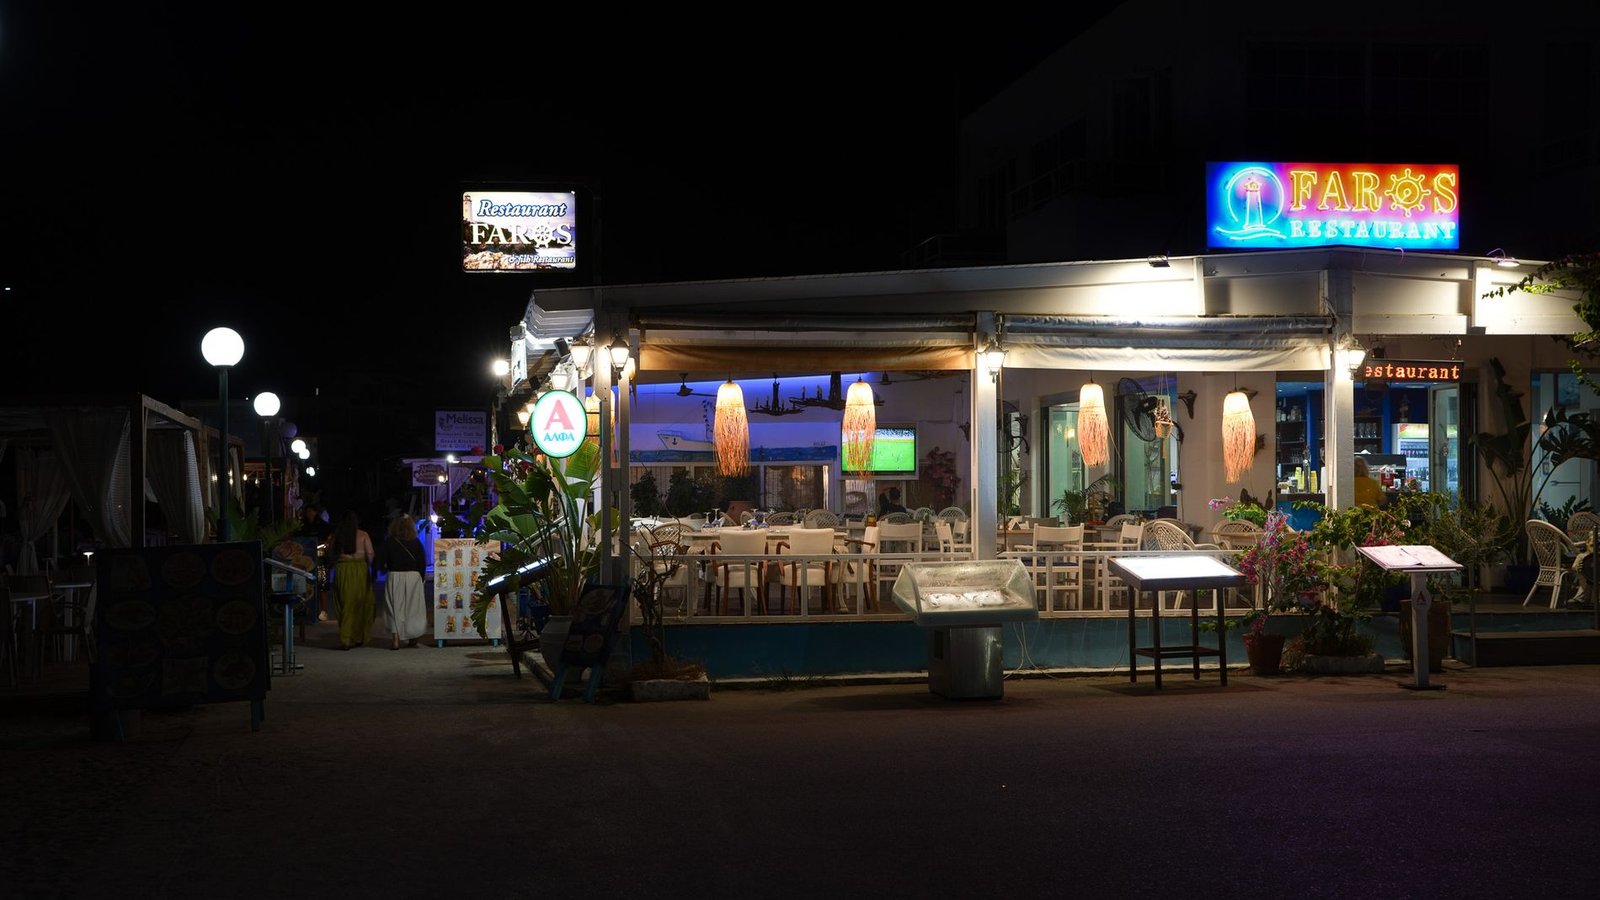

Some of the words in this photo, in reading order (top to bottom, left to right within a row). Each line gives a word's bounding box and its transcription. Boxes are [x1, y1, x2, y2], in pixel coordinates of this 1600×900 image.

[477, 199, 567, 217] Restaurant
[1289, 219, 1456, 240] RESTAURANT
[446, 413, 483, 424] Melissa
